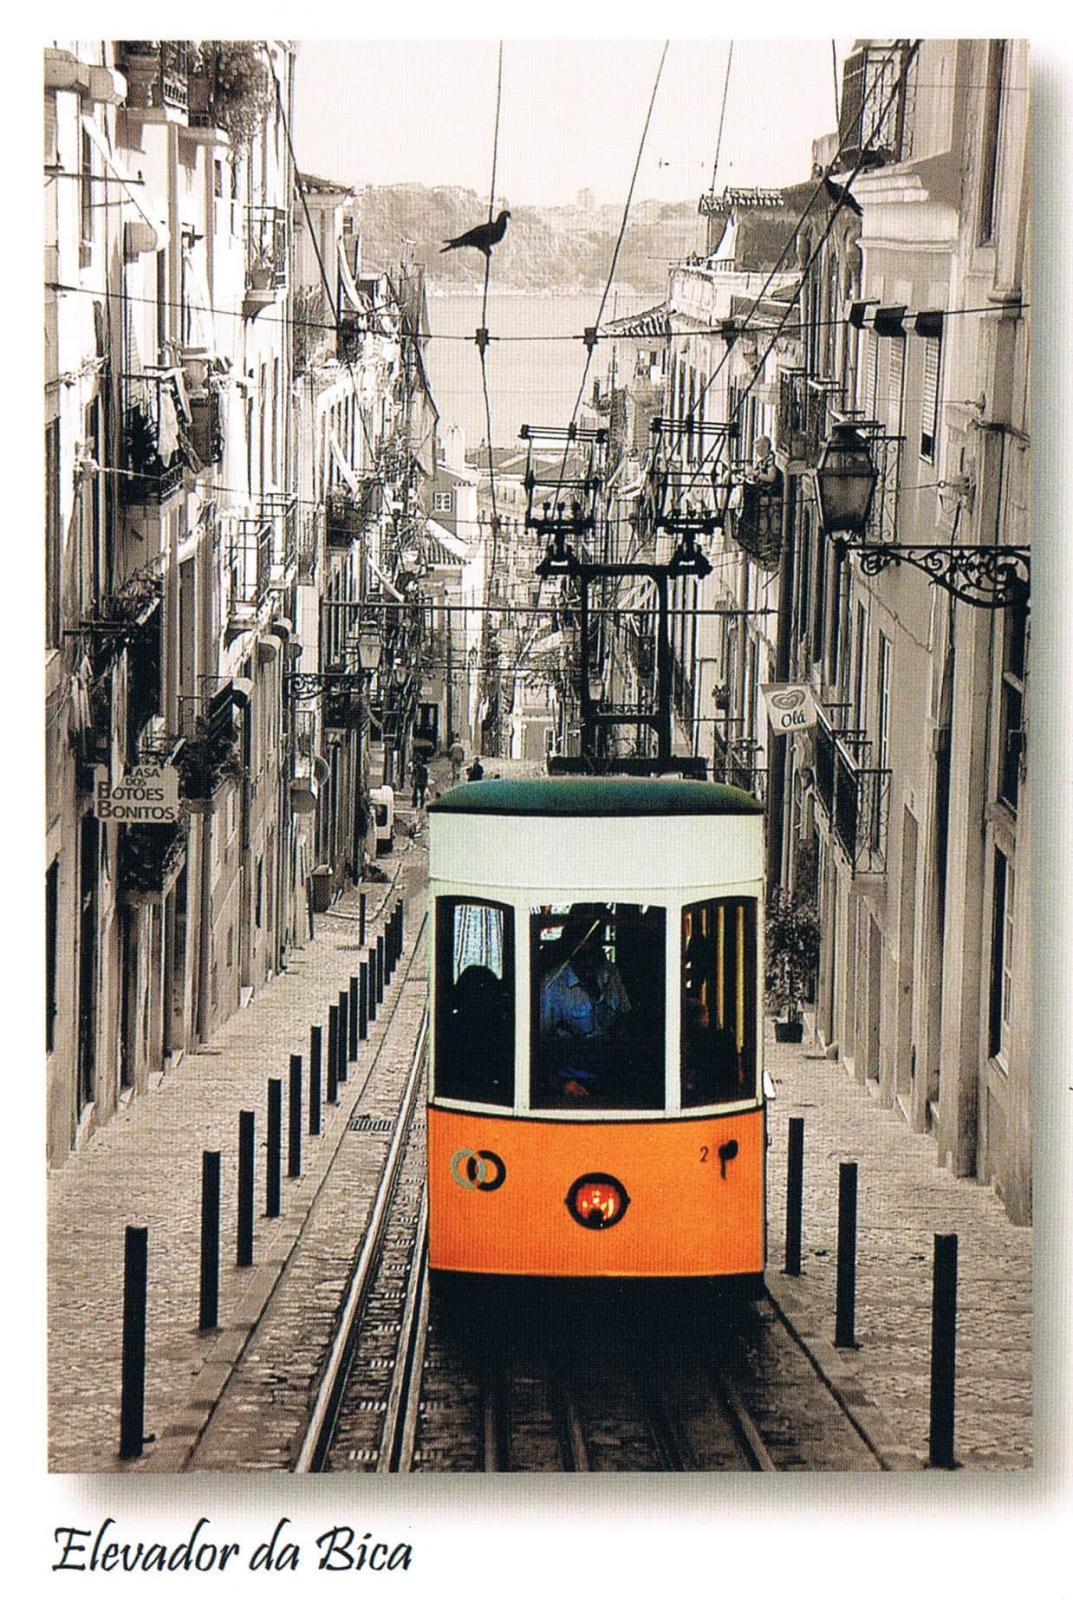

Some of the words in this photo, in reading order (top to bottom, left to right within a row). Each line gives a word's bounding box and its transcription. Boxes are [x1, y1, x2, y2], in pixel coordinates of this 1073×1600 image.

[781, 709, 806, 728] Olá
[128, 767, 160, 779] ASA
[125, 778, 147, 787] DOS
[98, 801, 175, 819] BONITOS
[700, 1146, 709, 1163] 2
